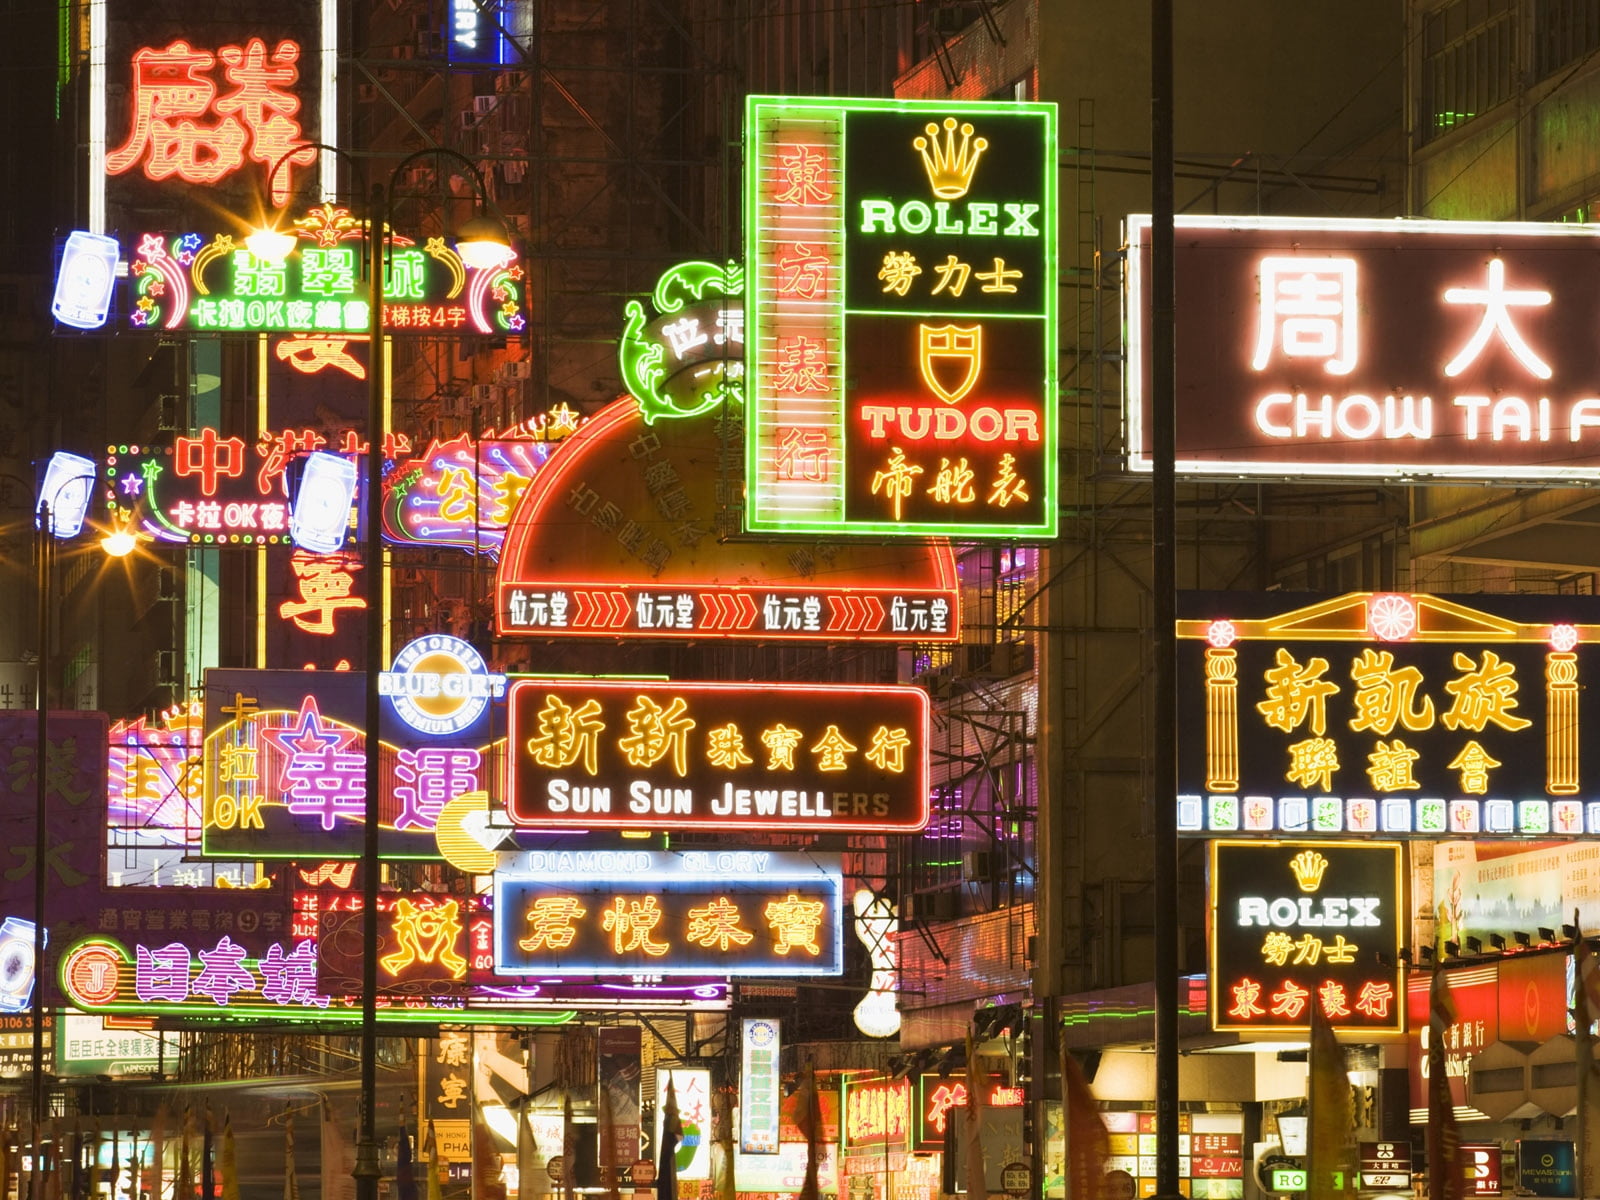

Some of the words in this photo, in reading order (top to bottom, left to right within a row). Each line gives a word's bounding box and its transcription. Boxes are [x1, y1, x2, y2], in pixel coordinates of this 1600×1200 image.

[860, 199, 1040, 237] ROLEX
[877, 251, 1024, 298] 勞力士
[1252, 256, 1553, 382] 周大
[861, 407, 1040, 442] TUDOR
[1255, 393, 1433, 440] CHOW
[1454, 396, 1550, 442] TAI
[509, 590, 569, 628] 位元堂
[635, 592, 695, 630] 位元堂
[763, 595, 822, 631] 位元堂
[890, 596, 949, 633] 位元堂
[378, 672, 441, 697] BLUE
[1256, 648, 1534, 737] 新凱旋
[527, 694, 911, 777] 新新珠寶金行
[1286, 737, 1502, 796] 聯誼會
[529, 852, 652, 873] DIAMOND
[682, 852, 769, 873] GLORY
[1238, 897, 1381, 927] ROLEX
[1262, 932, 1358, 966] 勞力士
[1229, 978, 1393, 1018] 東方表行
[1442, 1020, 1485, 1050] 新銀行
